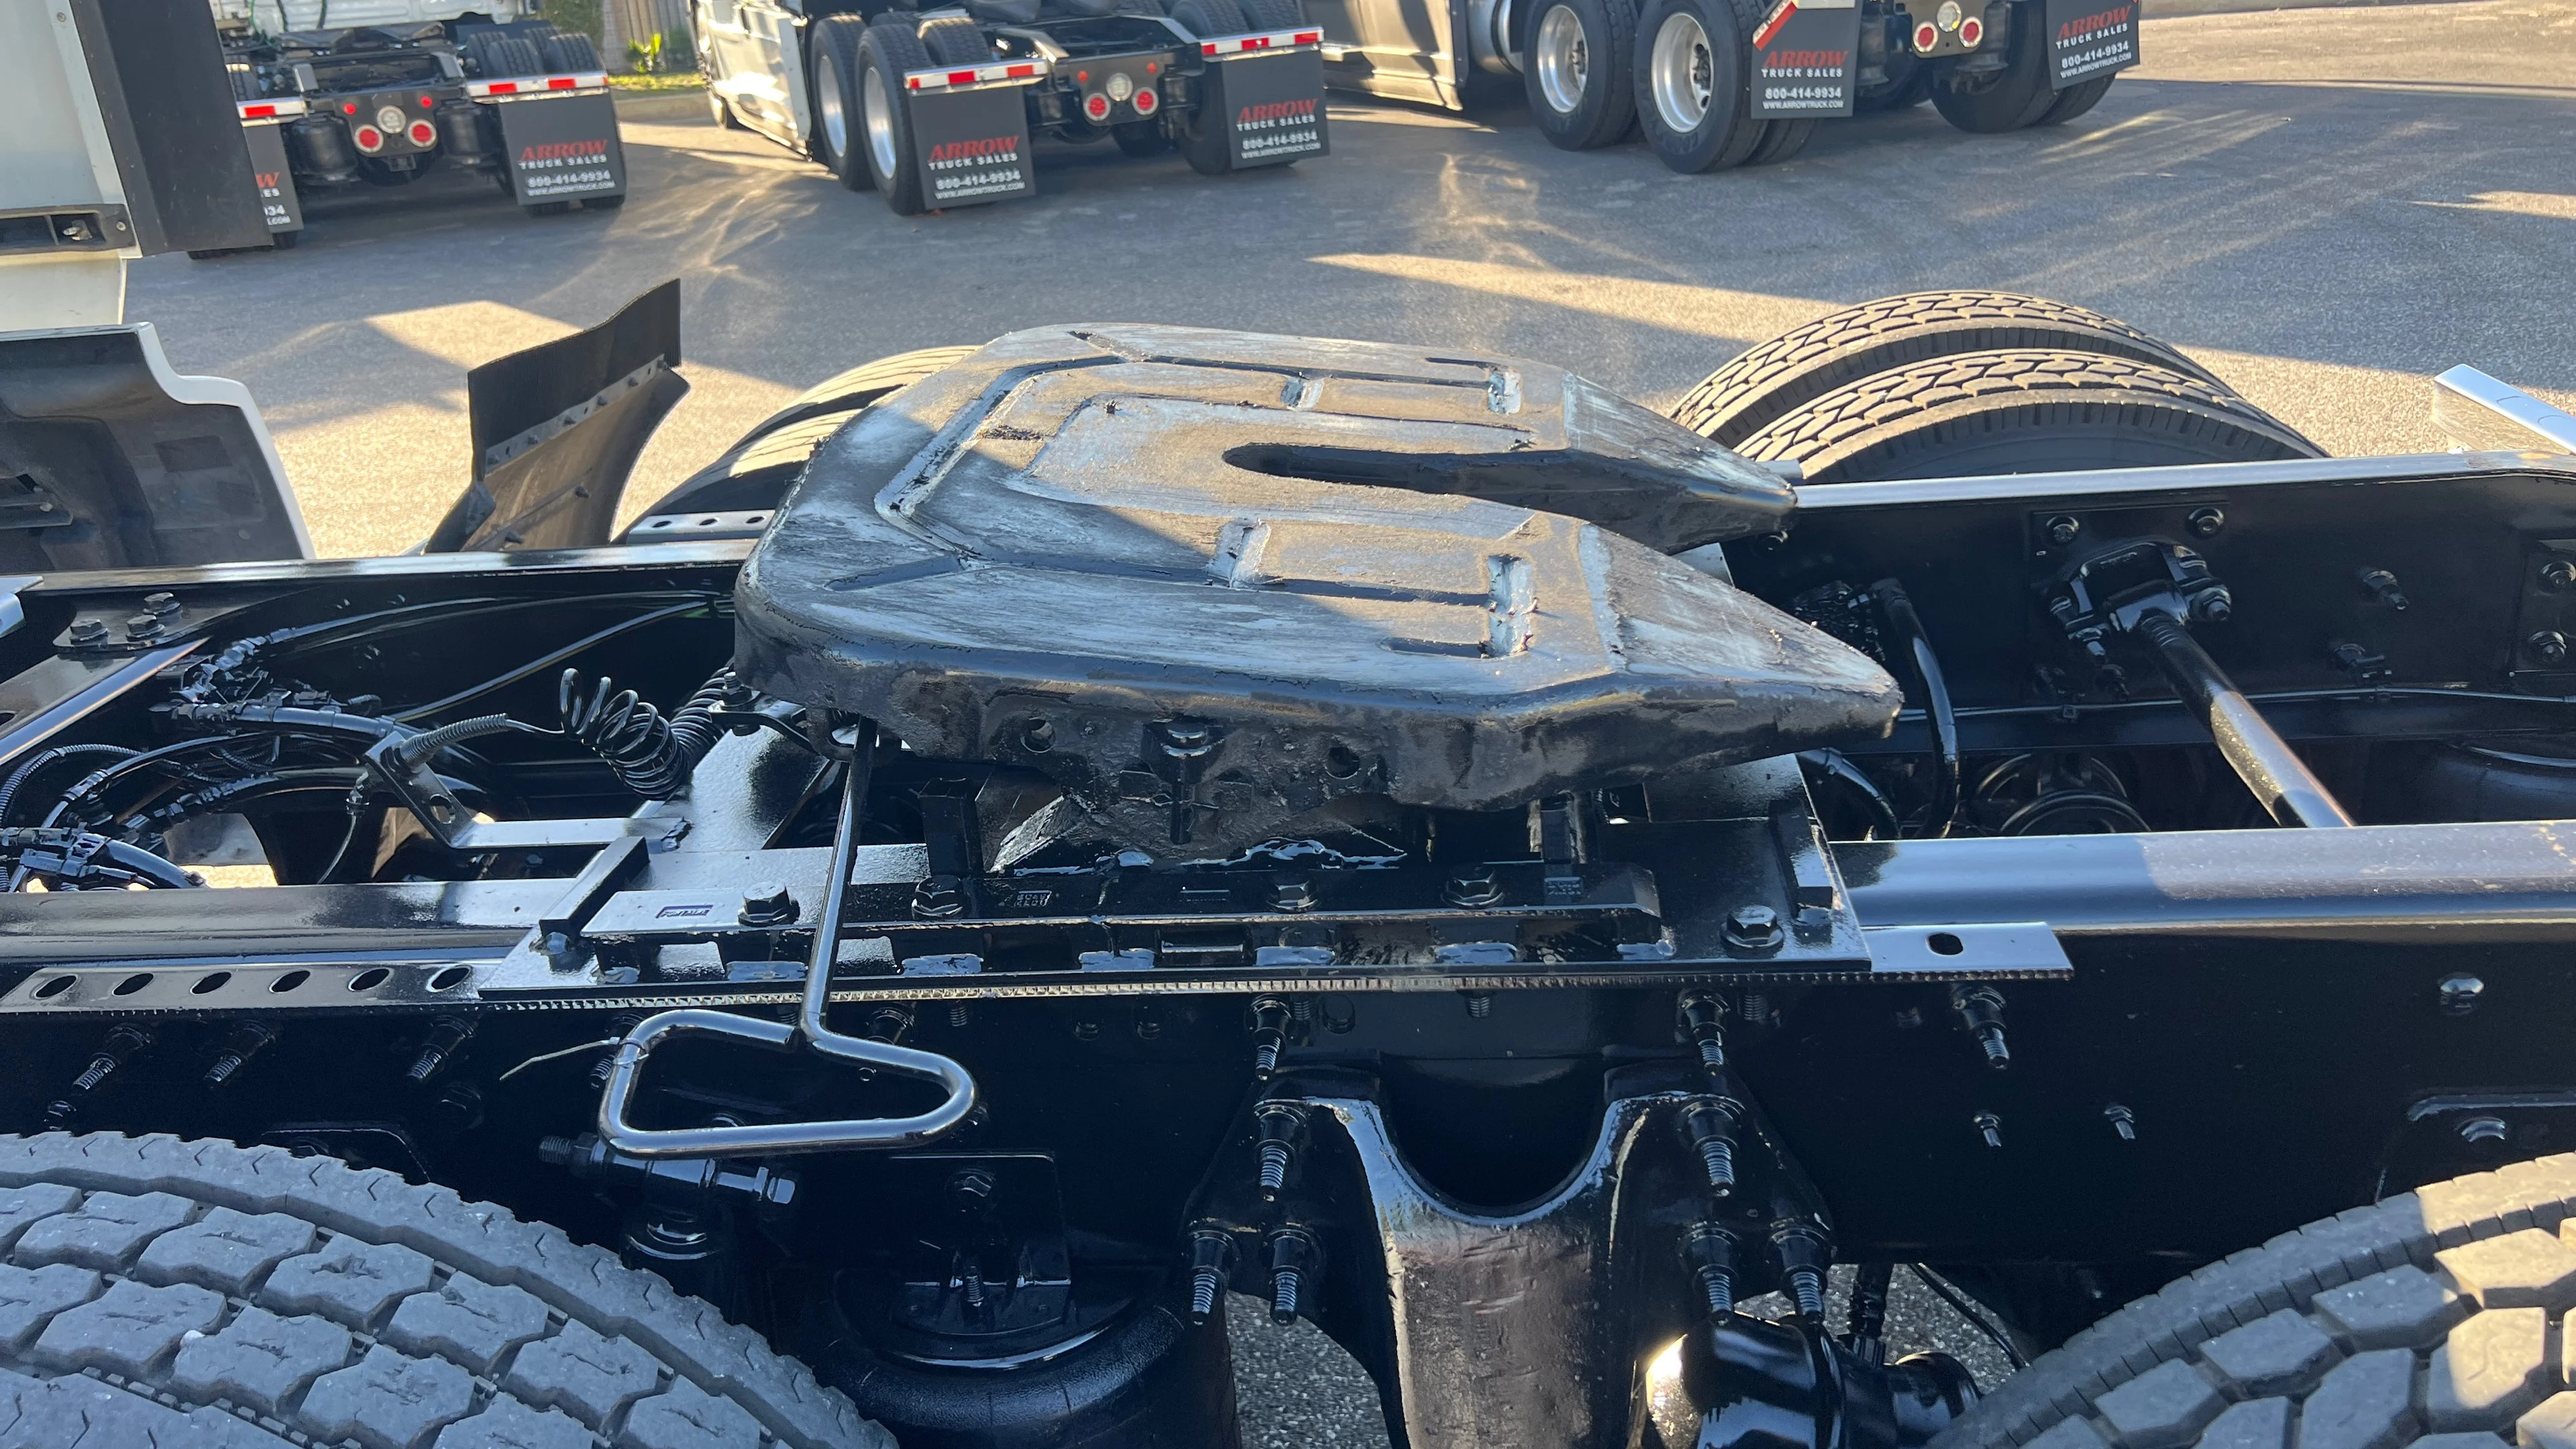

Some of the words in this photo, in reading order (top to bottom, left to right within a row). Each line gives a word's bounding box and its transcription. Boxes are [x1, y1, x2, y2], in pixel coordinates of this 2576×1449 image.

[2057, 5, 2132, 41] ARROW
[2055, 32, 2092, 50] TRUCK
[2096, 23, 2127, 39] SALES
[1762, 50, 1849, 68] ARROW
[2061, 40, 2129, 68] 800-414-9934
[1761, 68, 1802, 78] TRUCK
[1807, 68, 1843, 78] SALES
[1765, 87, 1841, 99] 800-414-9934
[1237, 99, 1319, 123] ARROW
[1762, 100, 1844, 109] WWW.ARROWTRUCK.COM
[1236, 119, 1275, 131] TRUCK
[1279, 114, 1316, 126] SALES
[519, 140, 608, 162] ARROW
[929, 135, 1020, 162] ARROW
[519, 158, 563, 170] TRUCK
[567, 154, 607, 166] SALES
[928, 157, 973, 170] TRUCK
[977, 152, 1018, 165] SALES
